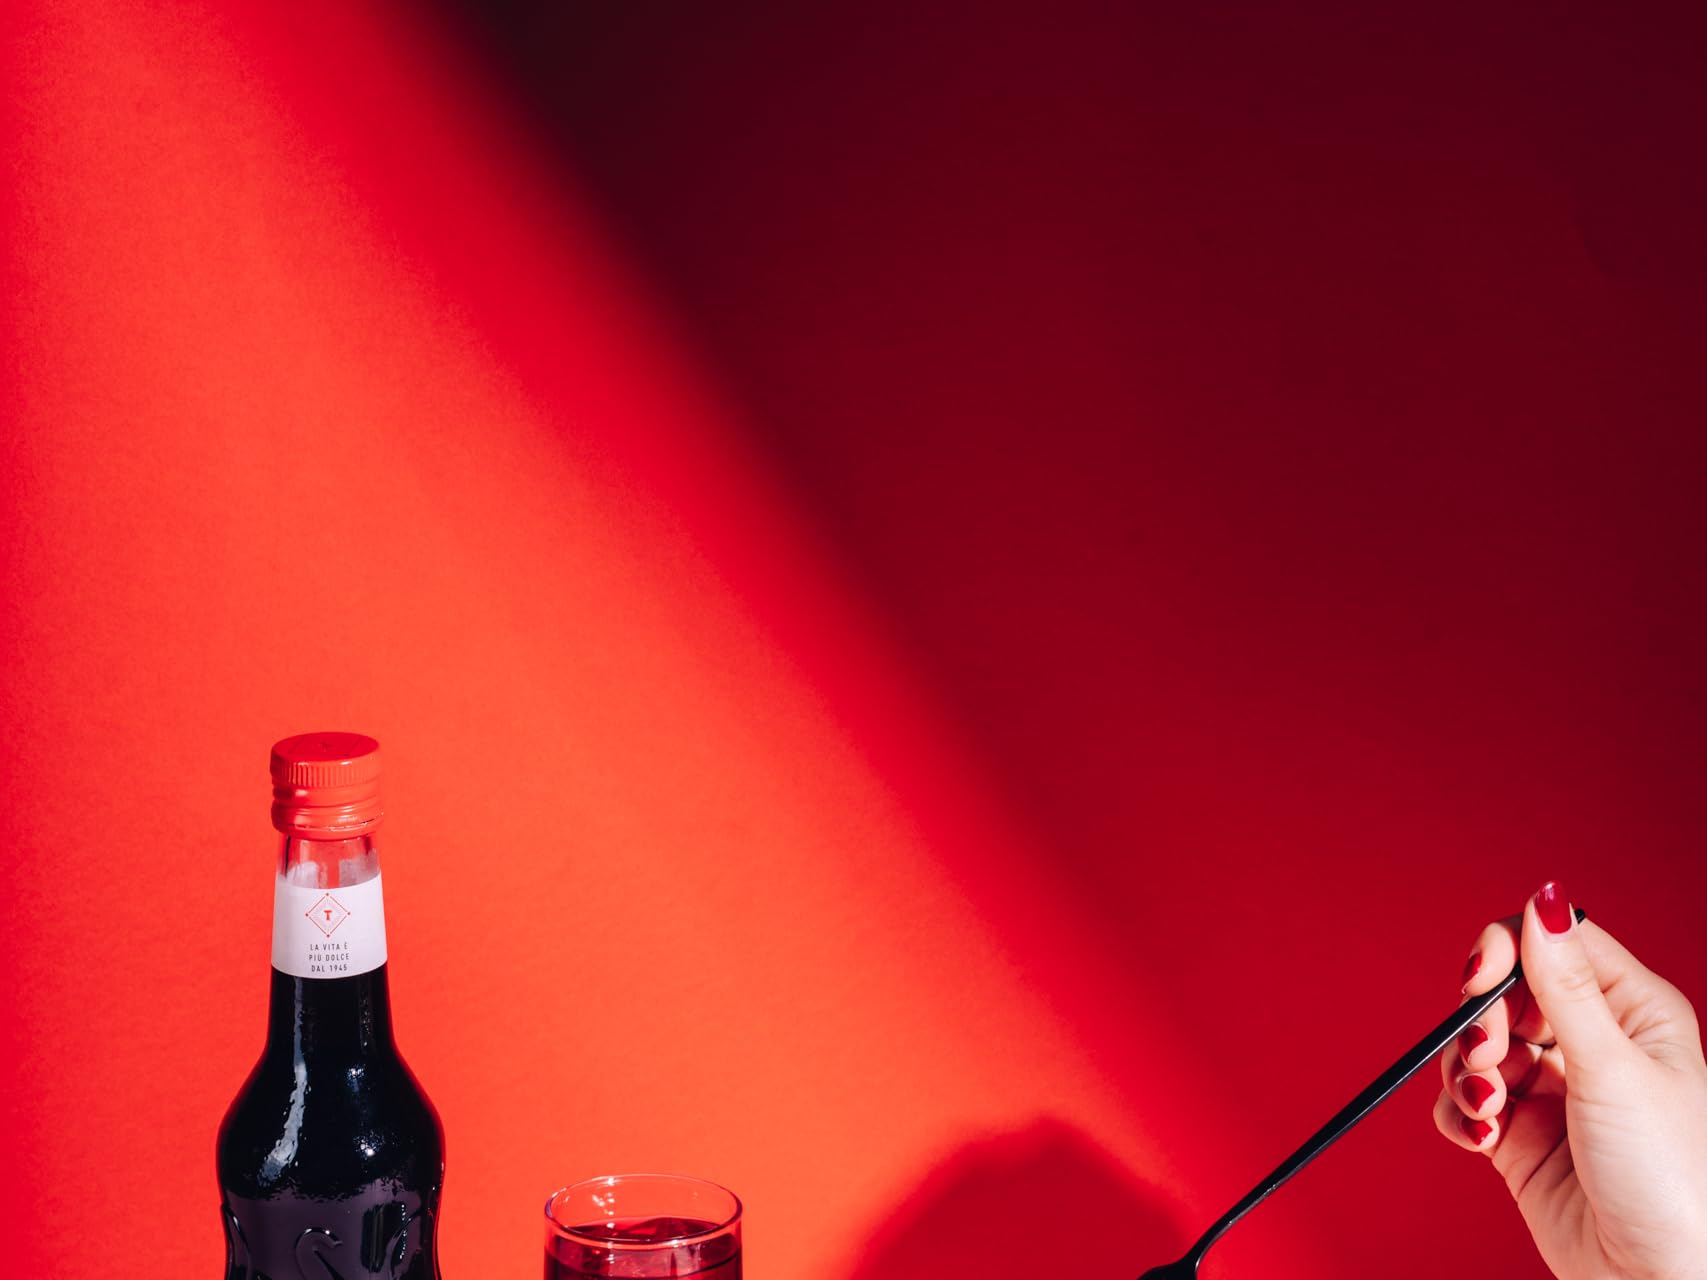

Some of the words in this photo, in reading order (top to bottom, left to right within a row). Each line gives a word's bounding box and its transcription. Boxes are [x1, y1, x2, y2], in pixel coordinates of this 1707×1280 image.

[323, 910, 332, 920] T
[322, 943, 340, 951] VITA
[326, 953, 349, 961] DOLCE
[329, 963, 347, 972] 1945
